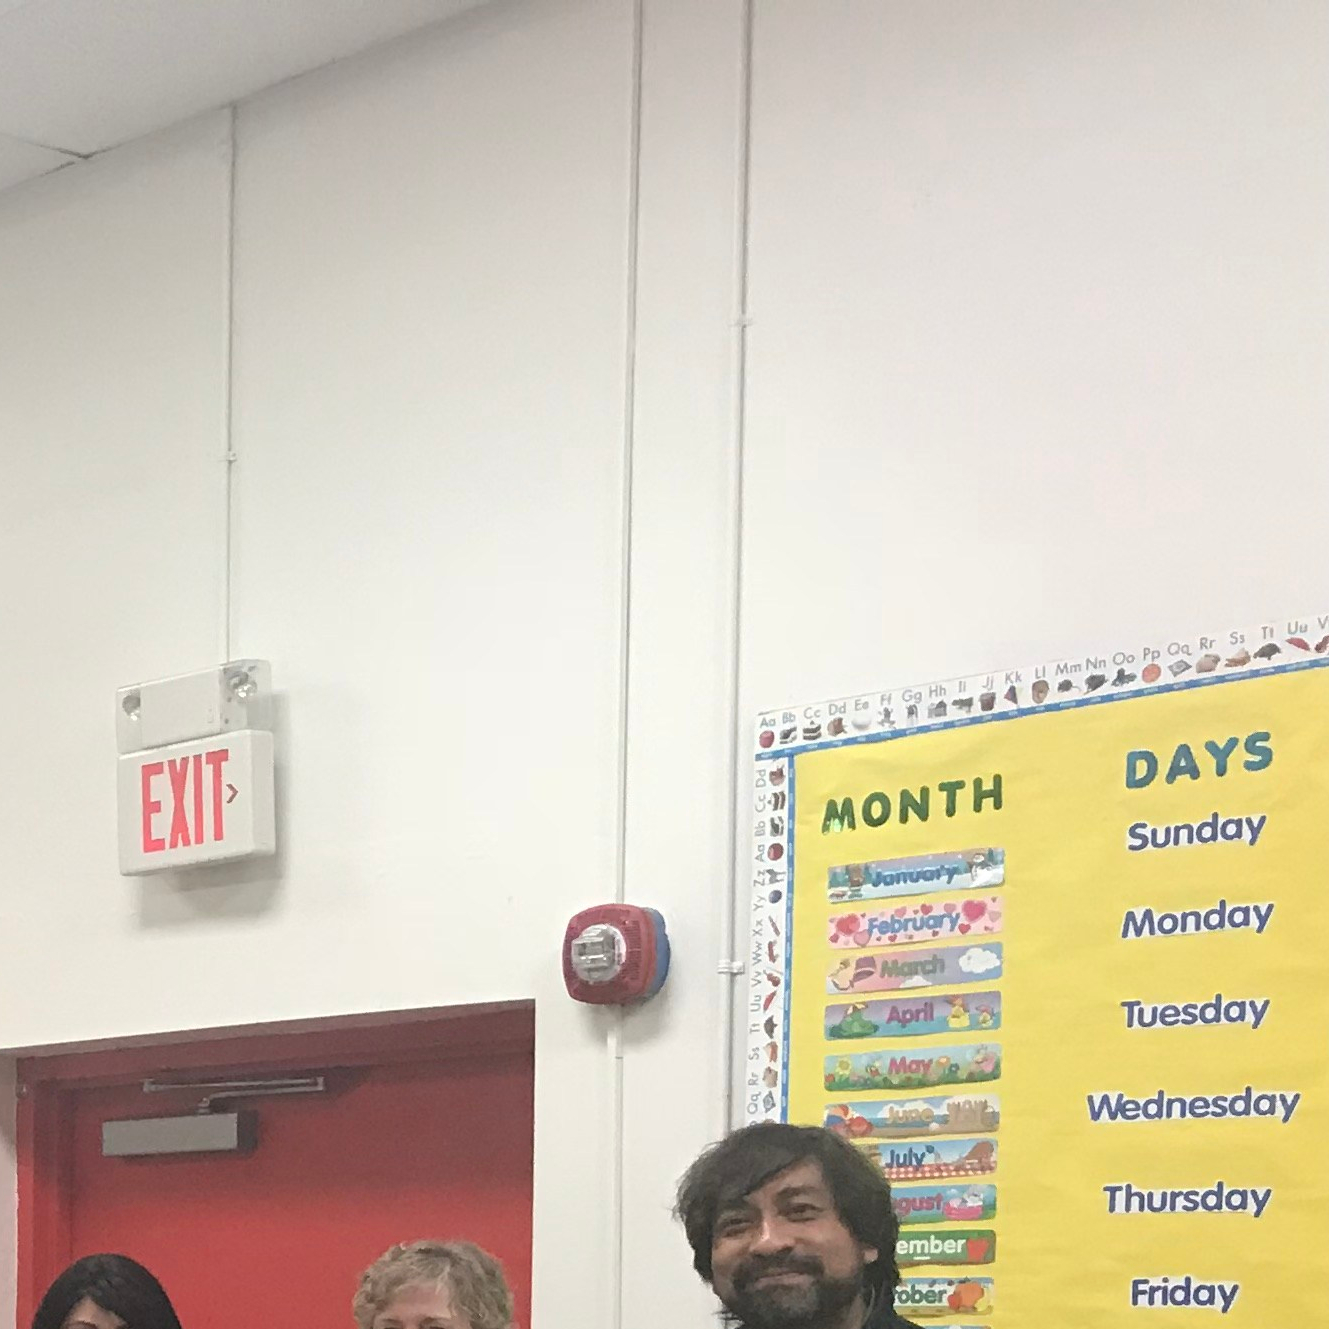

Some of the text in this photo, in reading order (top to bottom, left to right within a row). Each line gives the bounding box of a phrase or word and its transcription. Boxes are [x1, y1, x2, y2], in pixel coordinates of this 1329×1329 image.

[828, 702, 847, 715] Dd
[902, 689, 922, 704] Gg
[929, 684, 946, 698] Hh
[1004, 670, 1023, 684] Kk
[1055, 661, 1081, 676] Mm
[1086, 656, 1107, 671] Nn
[1112, 651, 1135, 666] Oo
[1143, 647, 1160, 665] Pp
[1200, 637, 1216, 650] Rr
[1288, 622, 1308, 635] Uu
[1125, 731, 1274, 789] DAYS
[141, 748, 230, 853] EXIT
[822, 773, 1004, 835] MONTH
[1128, 812, 1266, 852] Sunday
[871, 865, 959, 889] January
[867, 911, 961, 938] February
[1121, 899, 1274, 939] Monday
[880, 955, 945, 978] March
[887, 1002, 934, 1028] April
[1120, 994, 1271, 1029] Tuesday
[888, 1056, 933, 1076] May
[887, 1105, 934, 1125] June
[1087, 1087, 1301, 1124] Wednesday
[885, 1147, 926, 1169] July
[893, 1193, 944, 1216] gust
[1103, 1181, 1272, 1218] Thursday
[896, 1235, 966, 1255] ember
[1131, 1277, 1239, 1314] Friday
